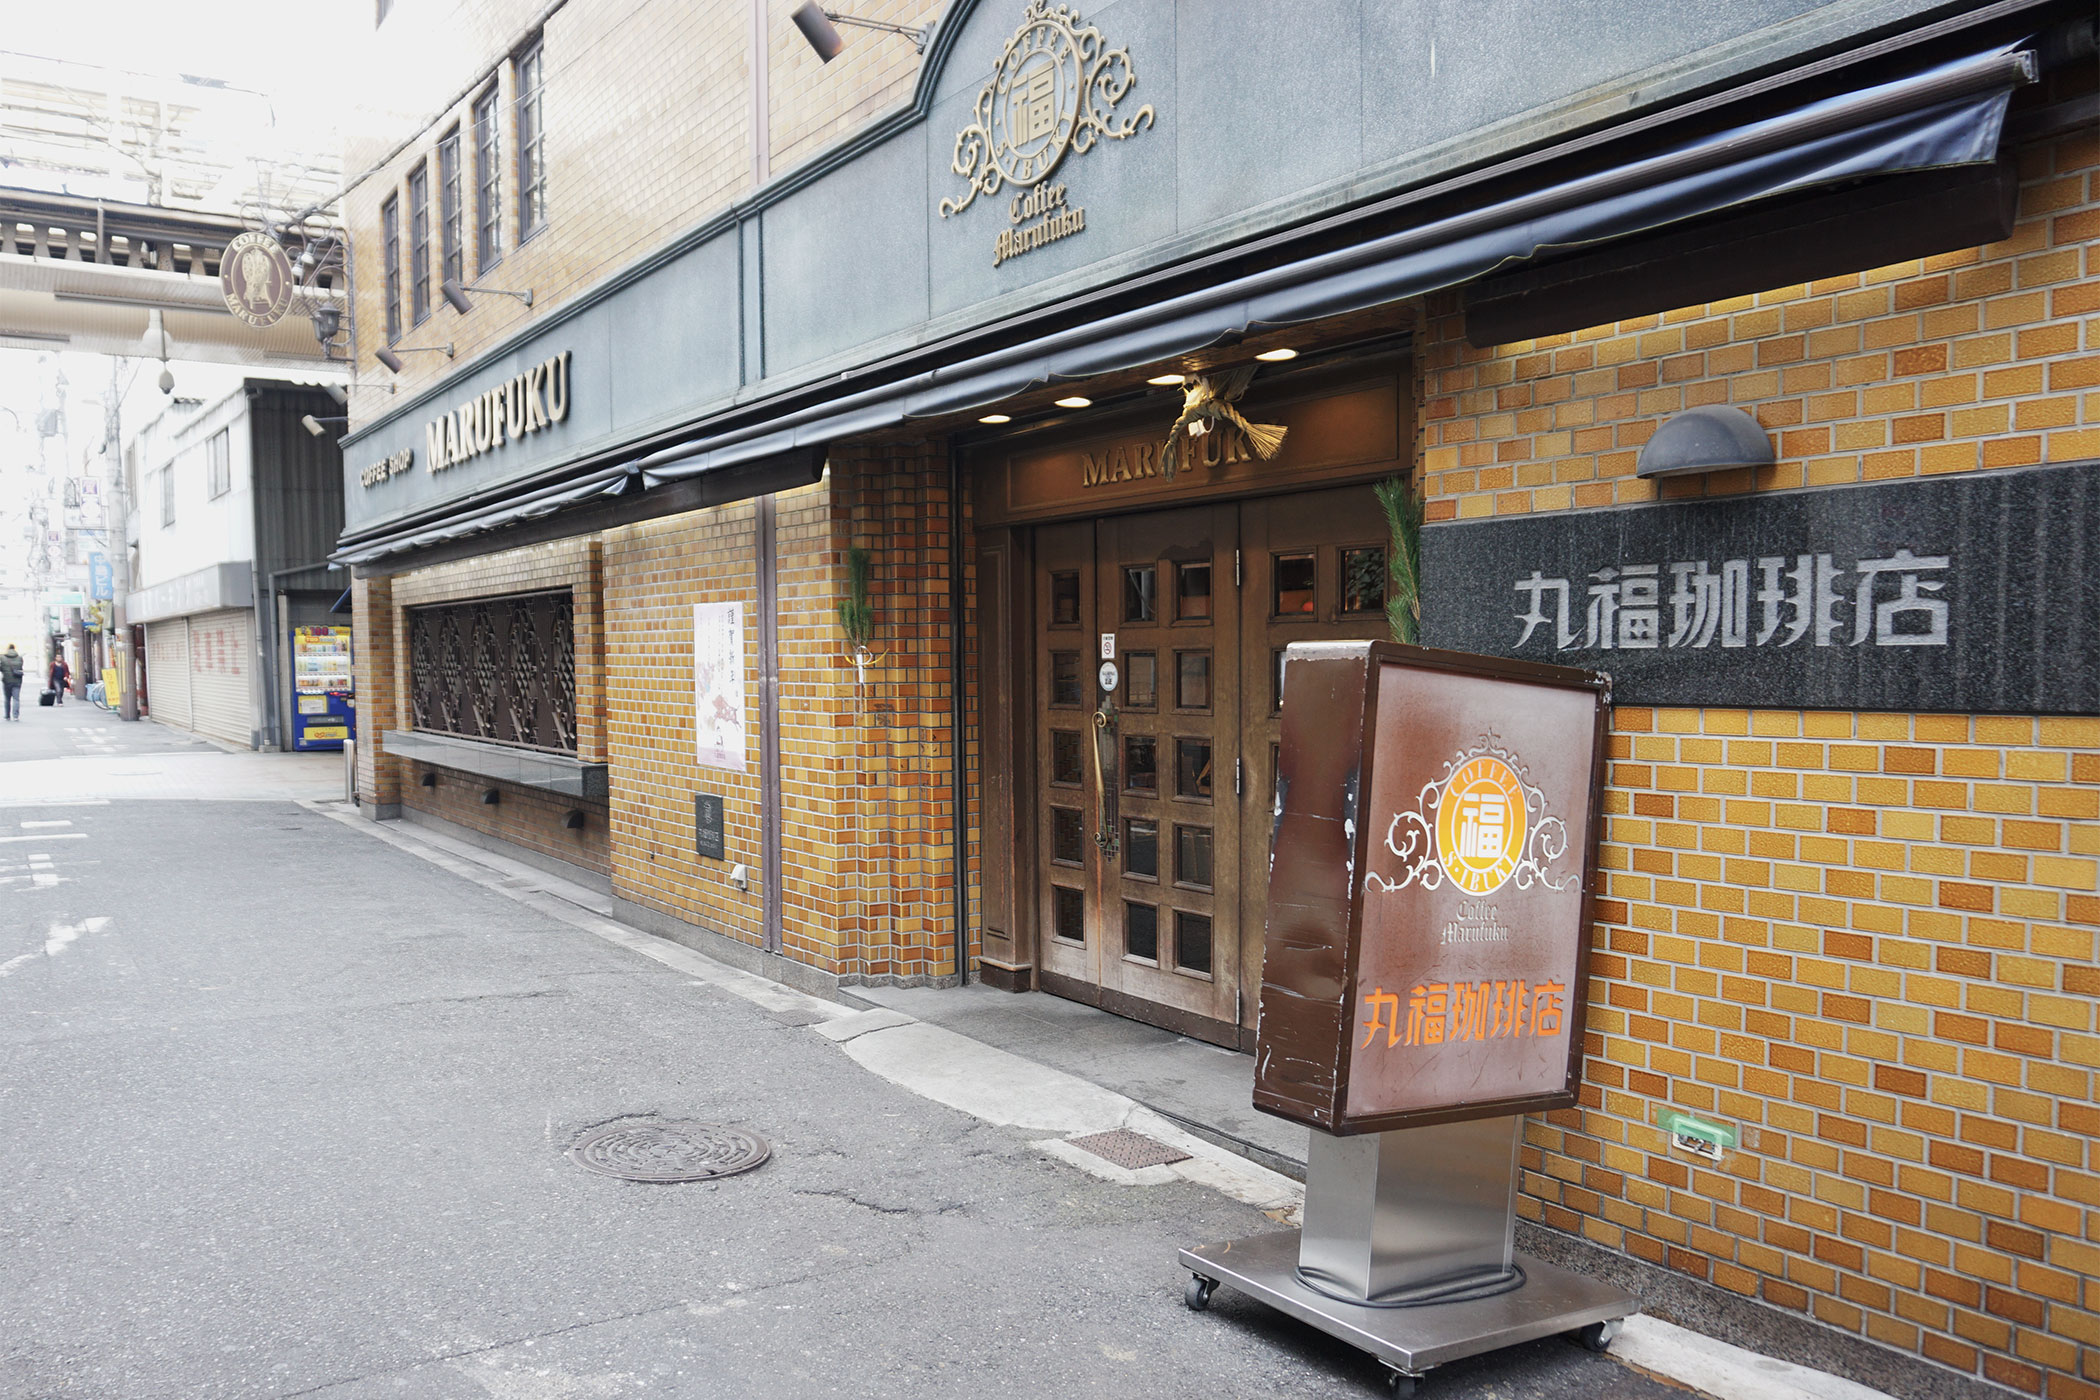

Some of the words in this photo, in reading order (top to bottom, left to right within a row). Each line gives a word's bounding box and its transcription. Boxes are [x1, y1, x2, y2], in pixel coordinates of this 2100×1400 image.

[996, 26, 1072, 95] COFFEE
[1012, 59, 1055, 148] 福
[1009, 181, 1067, 225] Coffee
[231, 233, 280, 252] COFFEE
[992, 206, 1086, 267] Marufuku
[360, 458, 389, 488] COFFEE
[389, 448, 414, 477] SHOP
[425, 350, 572, 473] MARUFUKU
[1082, 418, 1282, 487] MARFUK
[1512, 548, 1950, 649] 丸福珈琲店
[1450, 759, 1521, 798] COFFEE
[1460, 792, 1506, 858] 福
[1440, 921, 1510, 946] Marufuku
[1455, 900, 1499, 923] Coffee
[1360, 979, 1566, 1050] 丸福珈琲店
